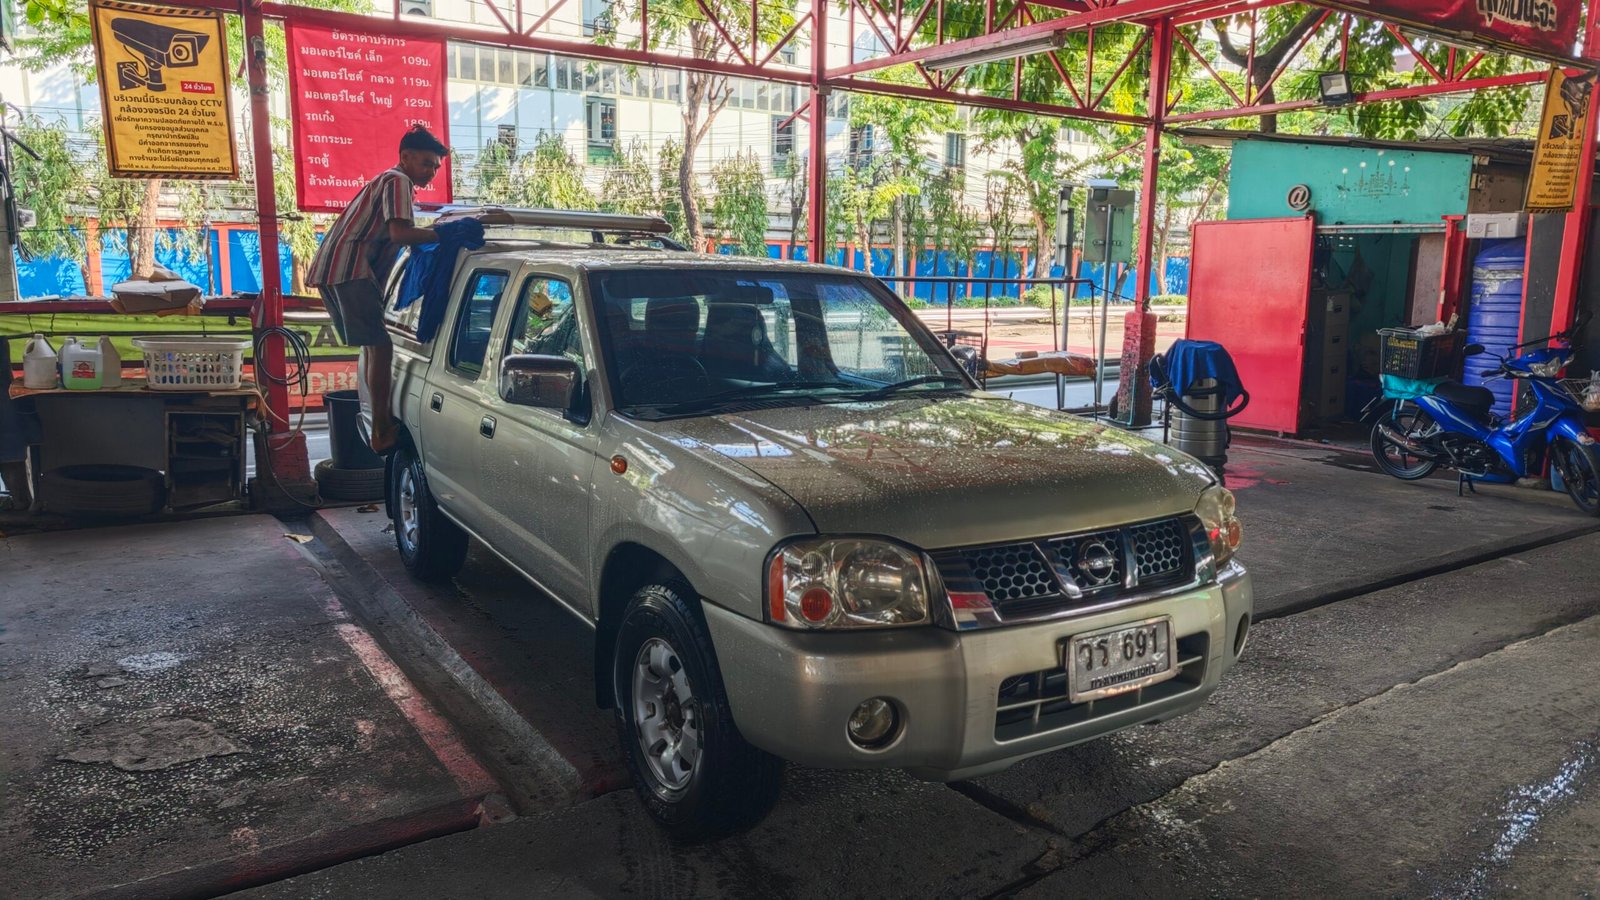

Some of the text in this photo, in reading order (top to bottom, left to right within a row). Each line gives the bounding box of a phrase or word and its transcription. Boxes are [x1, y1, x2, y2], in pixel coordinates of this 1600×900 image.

[365, 50, 383, 63] เล็ก
[402, 55, 432, 67] 109บ.
[370, 74, 395, 85] กลาง
[402, 77, 432, 87] 119บ.
[200, 99, 223, 107] CCTV
[370, 92, 393, 108] ใหญ่
[404, 98, 433, 108] 129บ.
[120, 105, 216, 118] กล้องวงจรปิด 24 ชั่วโมง
[305, 110, 335, 122] รถเก๋ง
[307, 134, 353, 145] รถกระบะ
[307, 153, 330, 168] รถตู้
[1123, 627, 1158, 661] 691
